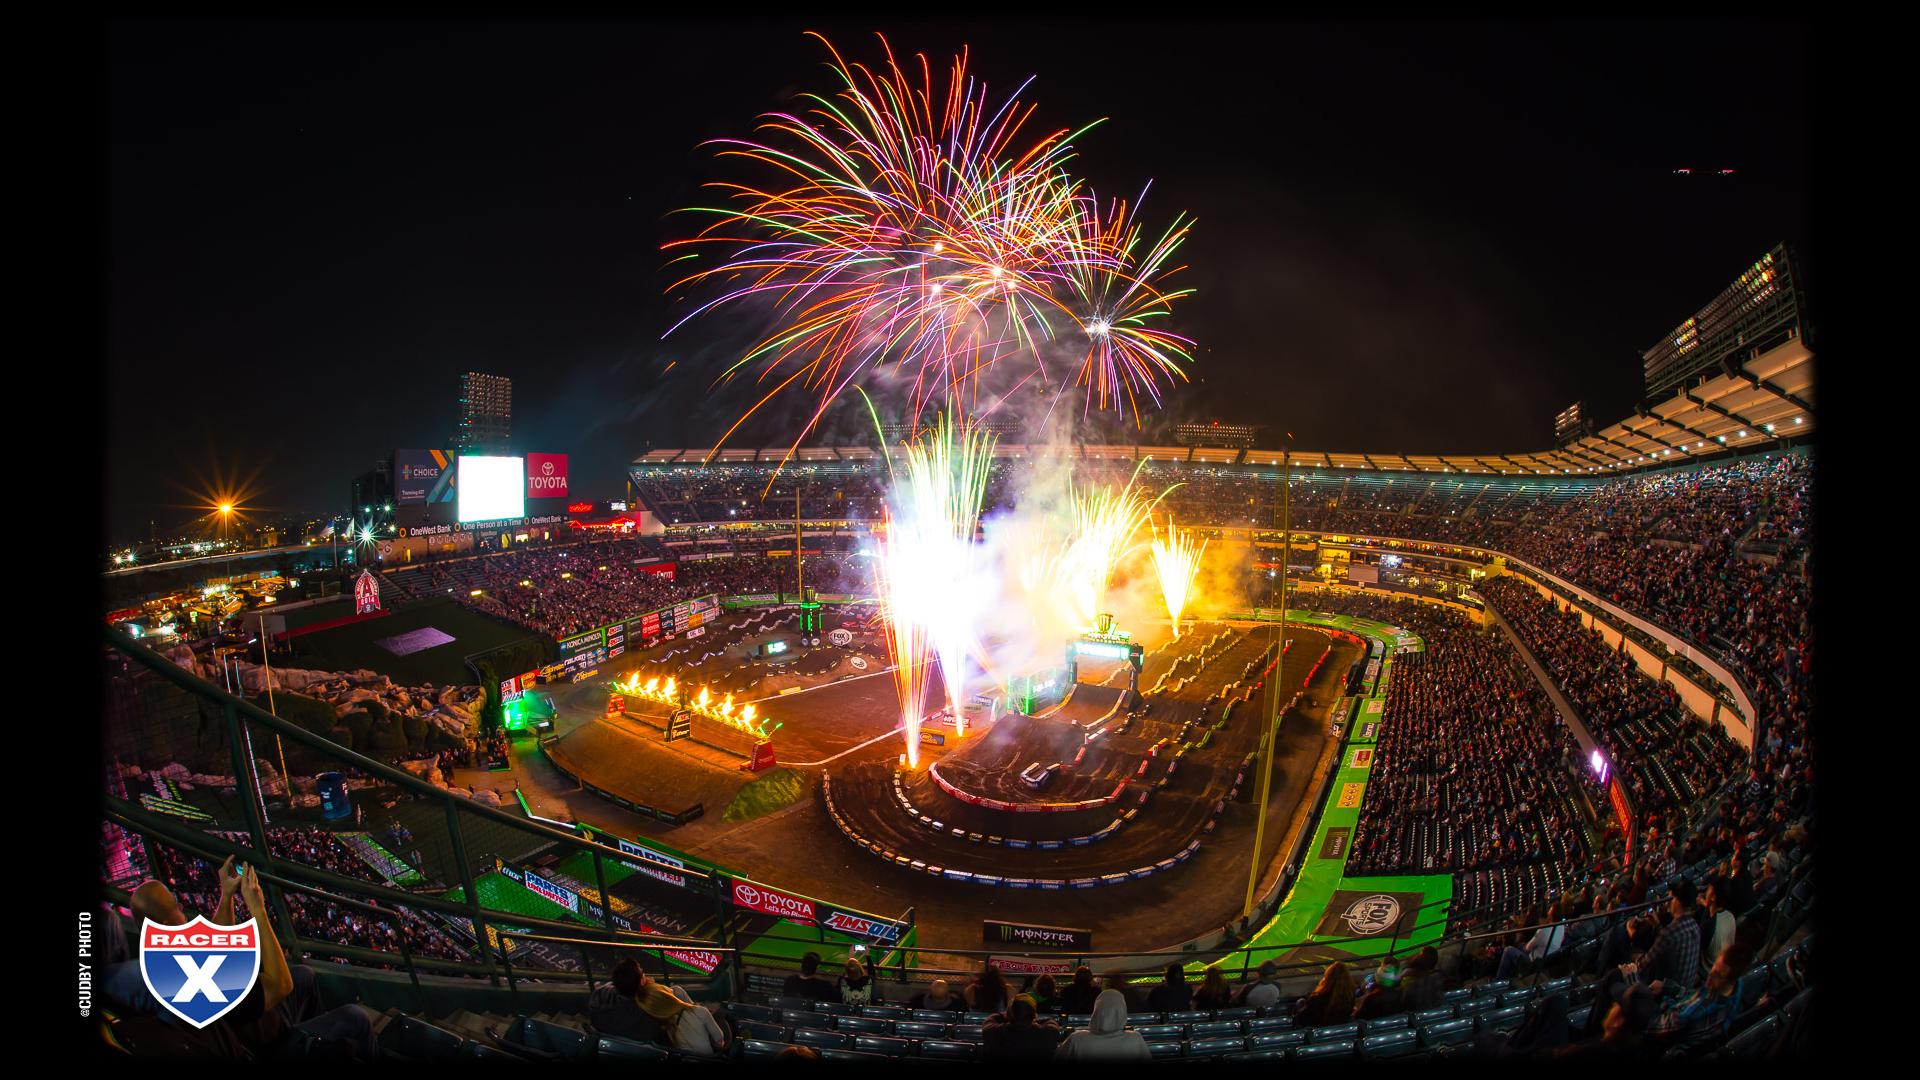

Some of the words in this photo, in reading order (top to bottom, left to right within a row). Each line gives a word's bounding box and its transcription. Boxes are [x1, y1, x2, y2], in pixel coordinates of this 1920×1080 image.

[413, 468, 438, 476] CHOICE
[528, 476, 567, 489] TOYOTA
[476, 521, 496, 530] Person
[509, 518, 522, 527] Time
[530, 517, 549, 526] OneWest
[550, 516, 561, 524] Bank
[410, 524, 436, 537] OneWest
[437, 522, 451, 533] Bank
[361, 597, 375, 605] 2014
[566, 640, 583, 649] KONICA
[502, 867, 523, 881] thor
[525, 872, 568, 899] PARTS
[527, 882, 569, 908] UNLIMITED
[761, 891, 812, 915] TOYOTA
[764, 903, 780, 912] Let's
[780, 907, 790, 916] Go
[1356, 903, 1372, 926] SPORTS
[1365, 903, 1392, 926] FOX
[824, 912, 900, 941] AMSOIL
[1014, 928, 1074, 943] MONSTER
